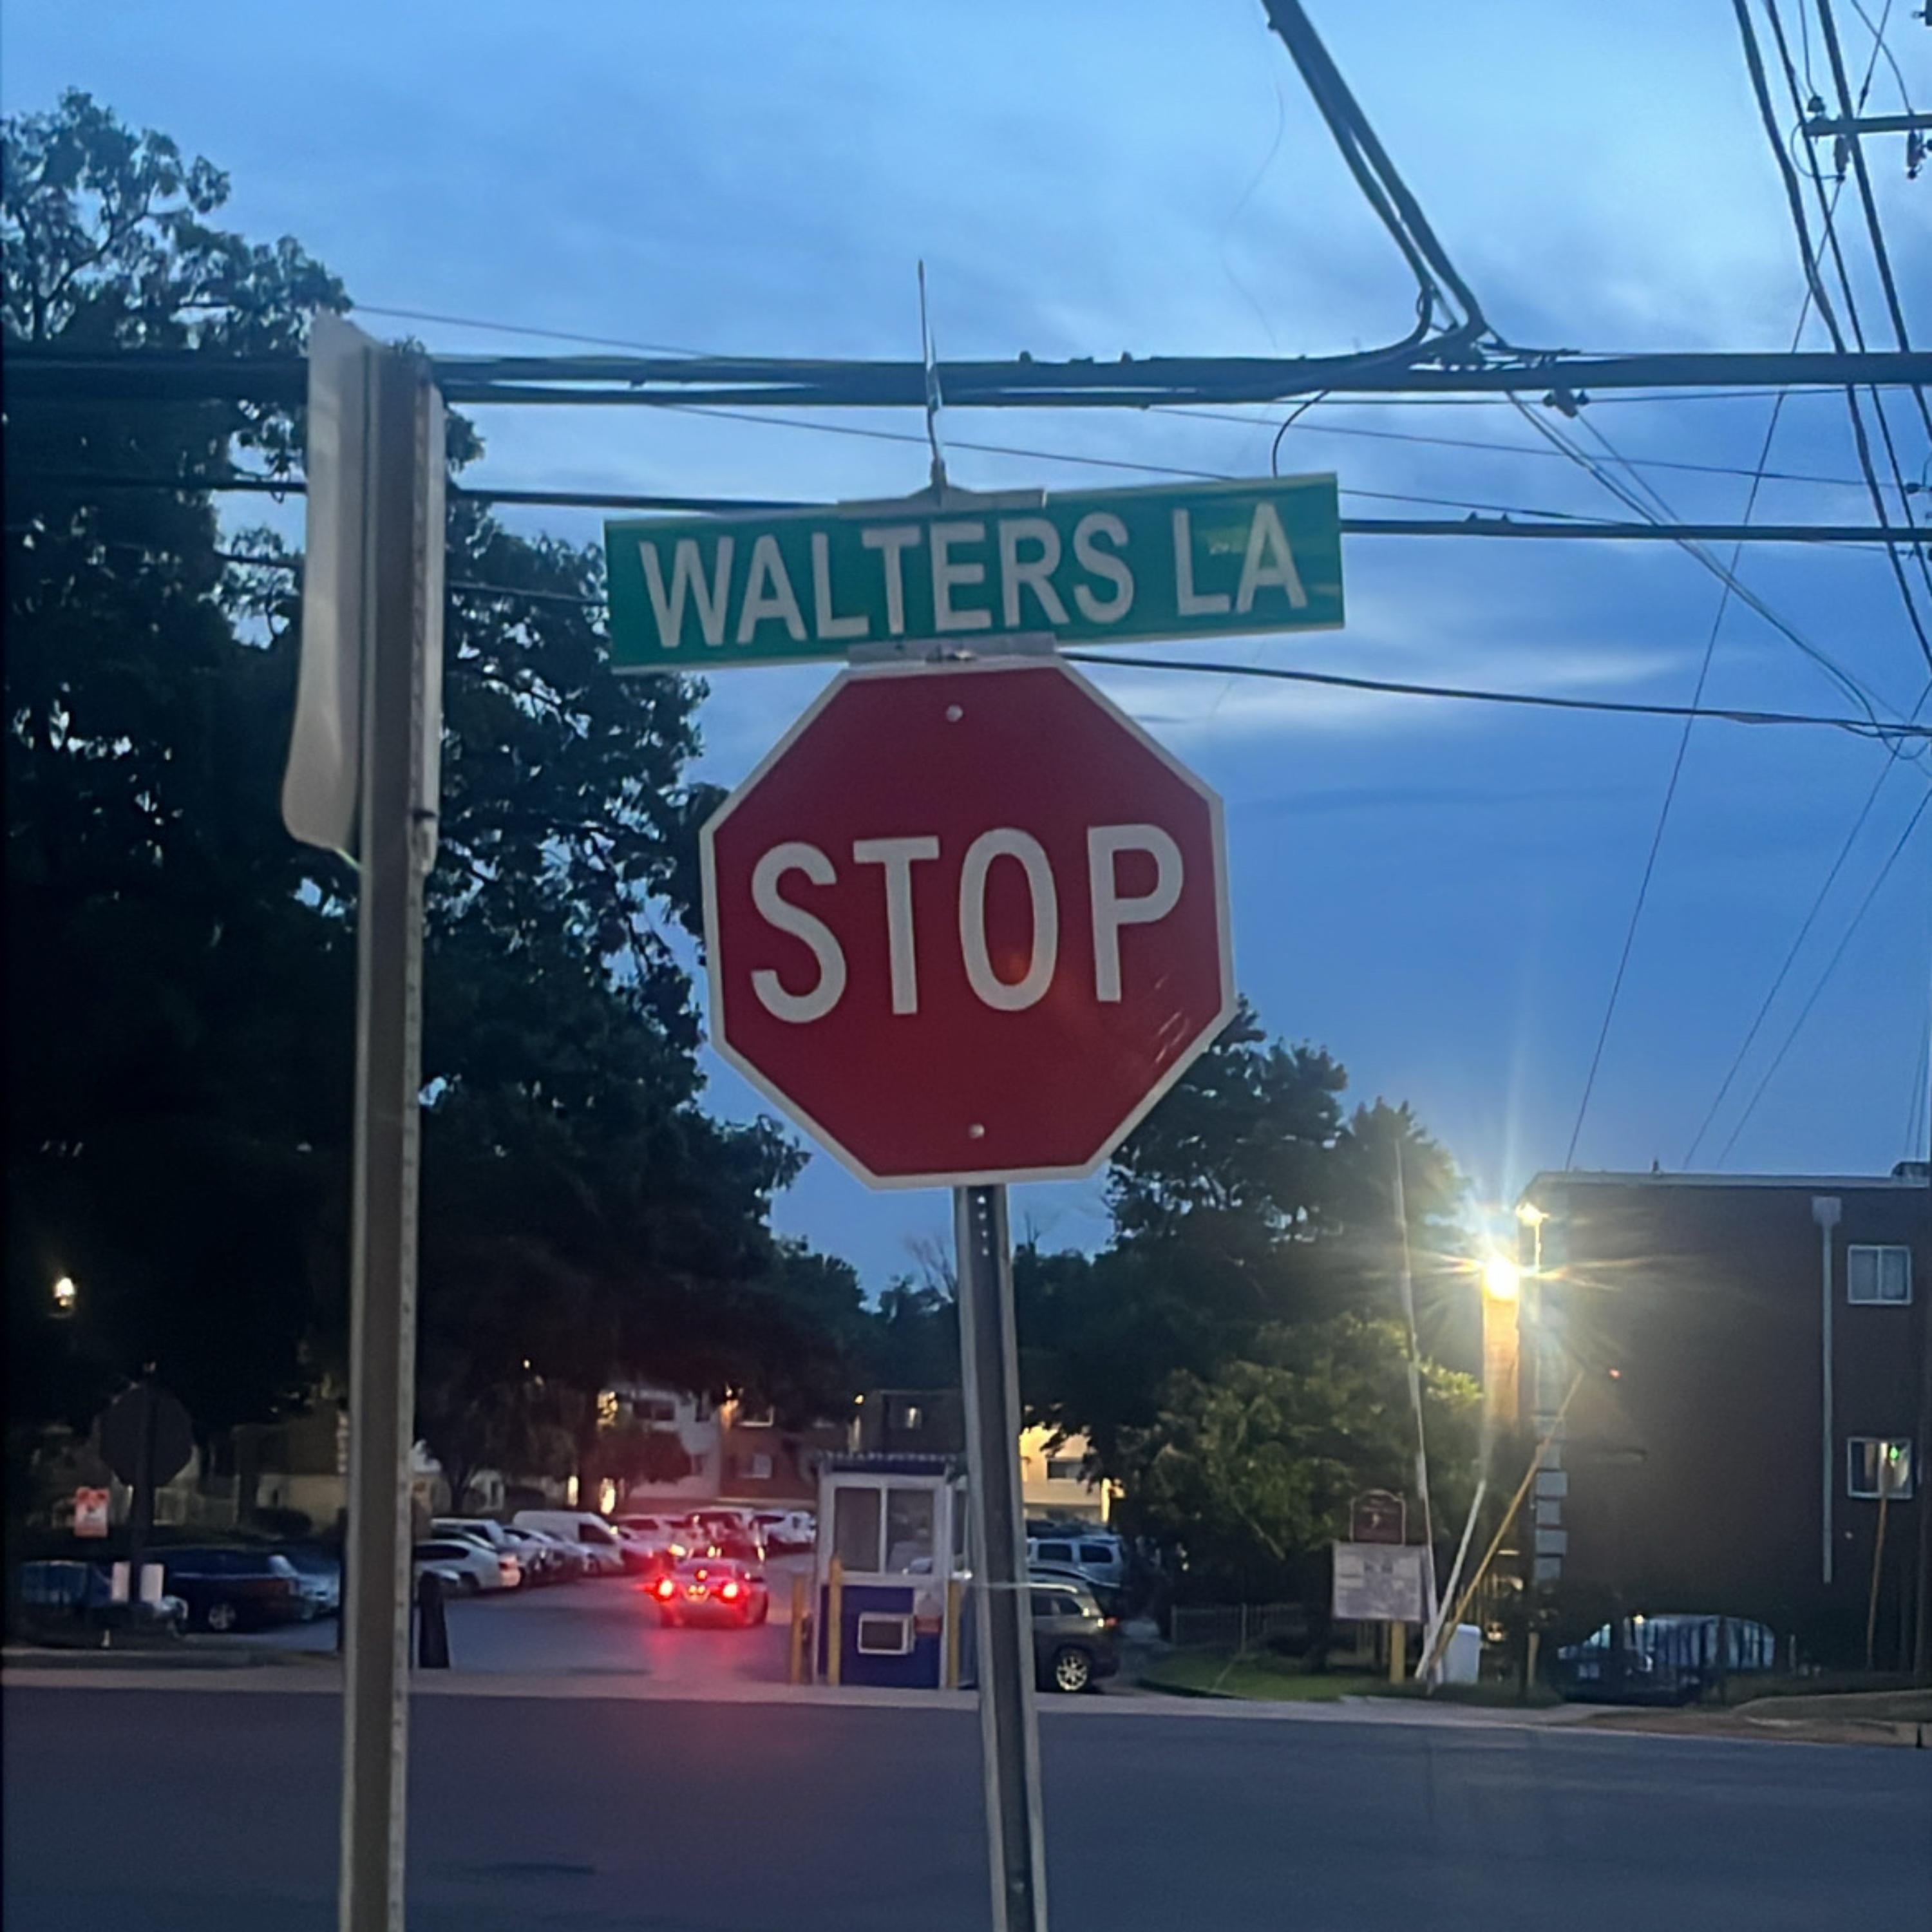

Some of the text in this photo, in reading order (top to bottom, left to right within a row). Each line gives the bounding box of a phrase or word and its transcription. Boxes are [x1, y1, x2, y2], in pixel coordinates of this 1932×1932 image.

[639, 503, 1307, 648] WALTERS LA
[750, 824, 1184, 1023] STOP
